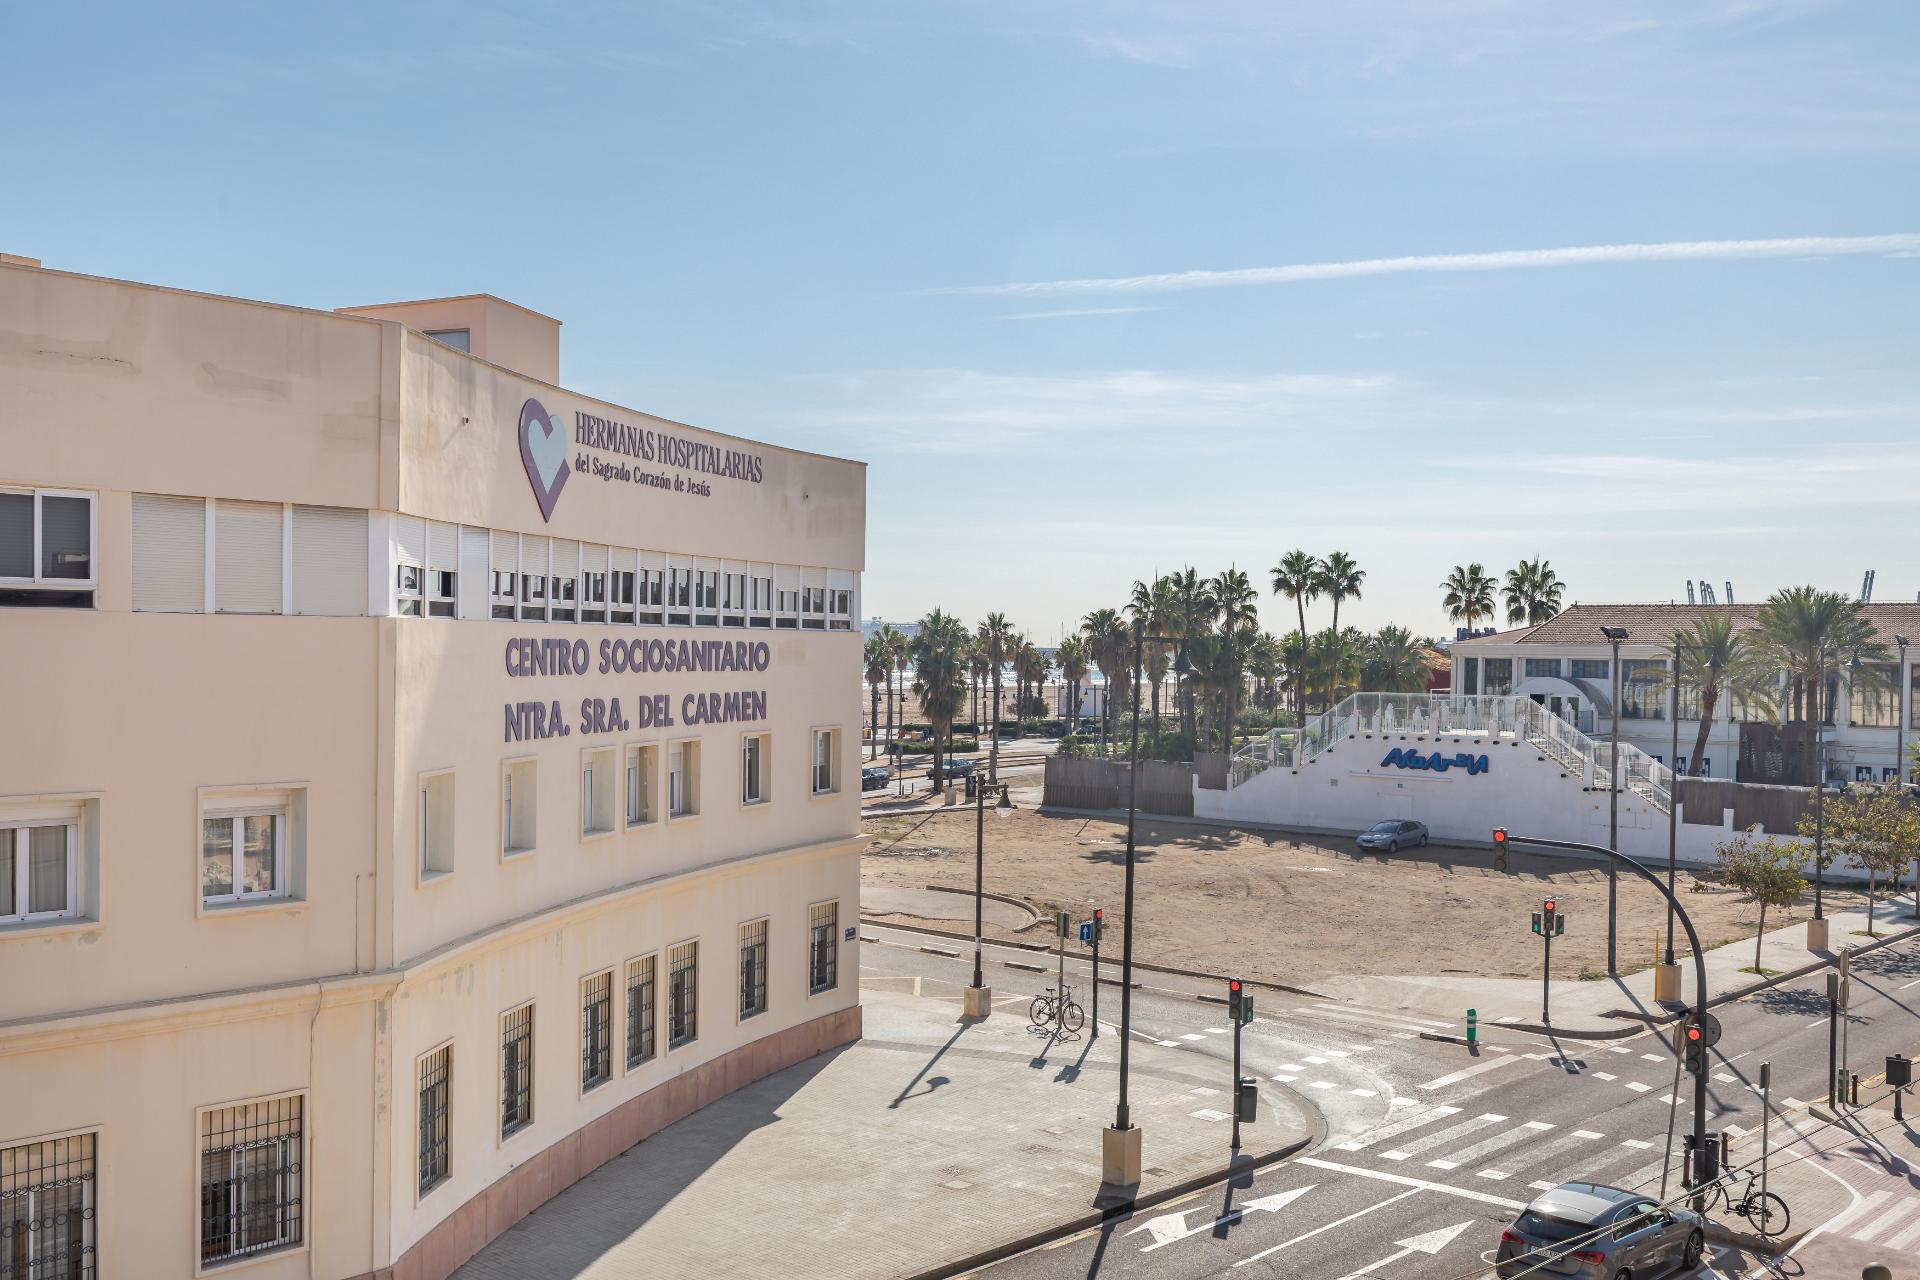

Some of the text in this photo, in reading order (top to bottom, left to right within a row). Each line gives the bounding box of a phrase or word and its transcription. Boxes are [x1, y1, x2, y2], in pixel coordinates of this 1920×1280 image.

[575, 411, 762, 483] HERMANAS HOSPITALARIAS
[575, 453, 711, 497] del Sagrado Corazón de Jesús
[505, 637, 770, 677] CENTRO SOCIOSANITARIO
[504, 690, 767, 742] NTRA. SRA. DEL CARMEN
